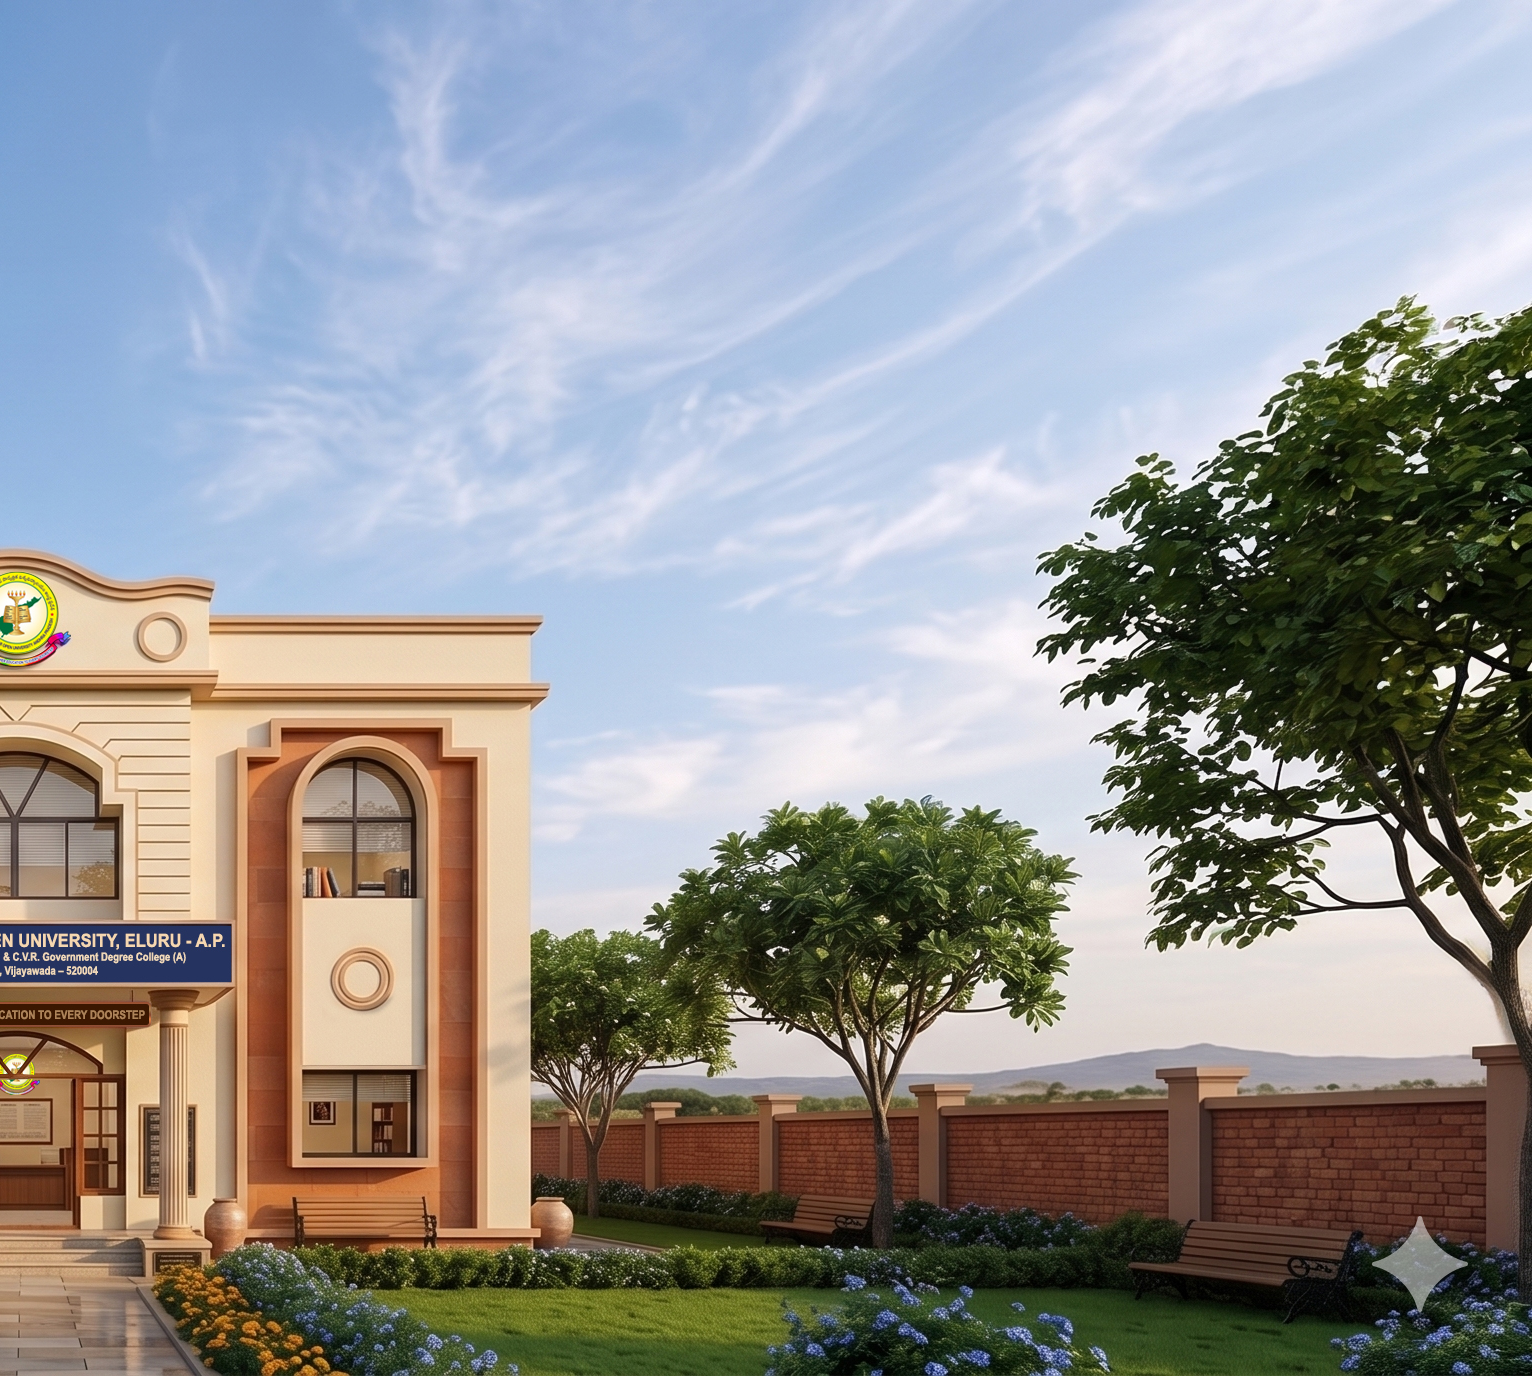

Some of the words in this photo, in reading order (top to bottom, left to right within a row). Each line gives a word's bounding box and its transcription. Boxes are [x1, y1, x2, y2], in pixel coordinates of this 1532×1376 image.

[19, 933, 119, 950] UNIVERSITY,
[125, 933, 181, 948] ELURU
[196, 933, 225, 948] A.P.
[3, 952, 10, 962] &
[13, 952, 40, 962] C.V.R.
[42, 952, 99, 962] Government
[101, 952, 134, 964] Degree
[136, 952, 170, 964] College
[173, 952, 187, 964] (A)
[4, 966, 56, 977] Vijayawada
[66, 966, 98, 976] 520004
[38, 1010, 51, 1020] TO
[54, 1010, 87, 1020] EVERY
[90, 1010, 145, 1020] DOORSTEP
